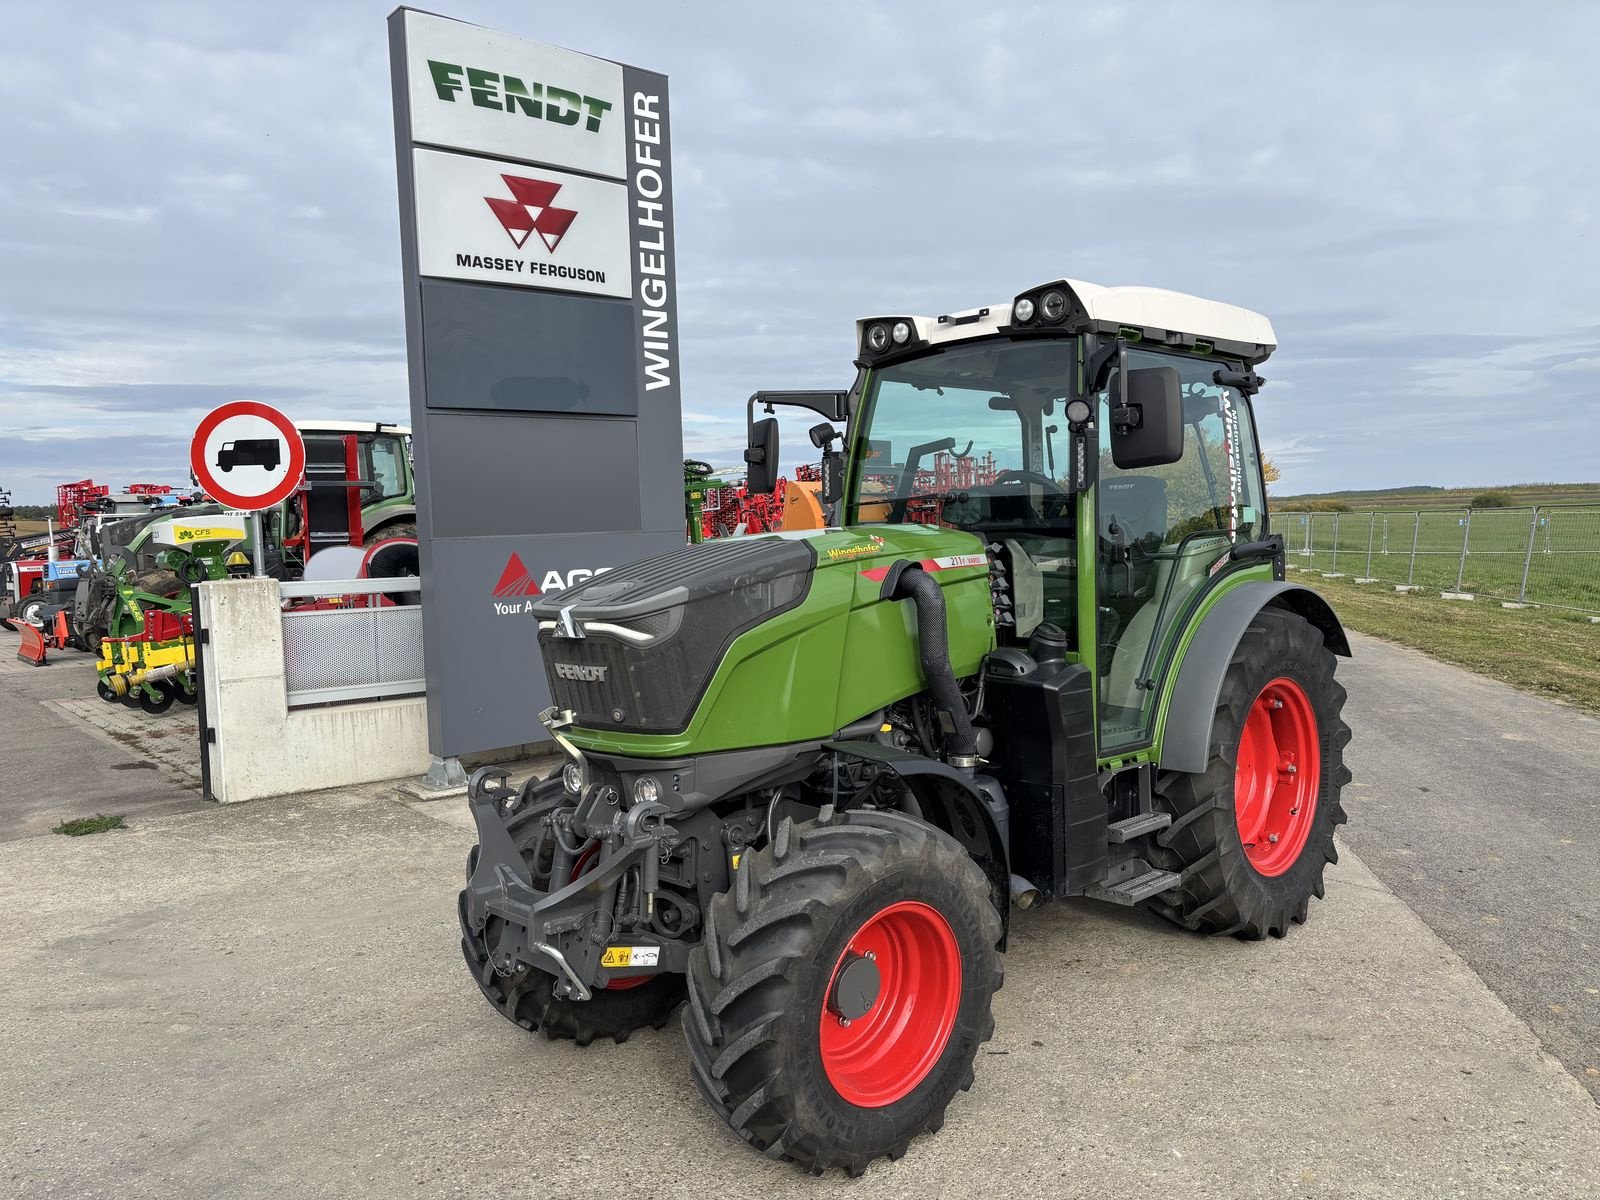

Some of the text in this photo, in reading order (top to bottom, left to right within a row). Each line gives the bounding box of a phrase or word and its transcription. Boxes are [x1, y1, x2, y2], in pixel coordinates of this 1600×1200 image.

[427, 59, 613, 133] FENDT
[633, 91, 671, 391] WINGELHOFER
[456, 253, 606, 284] MASSEY FERGUSON
[1109, 483, 1136, 491] FENDT
[194, 528, 211, 536] CFS
[541, 567, 615, 595] AG
[494, 601, 521, 616] Your
[554, 662, 608, 683] FENDT
